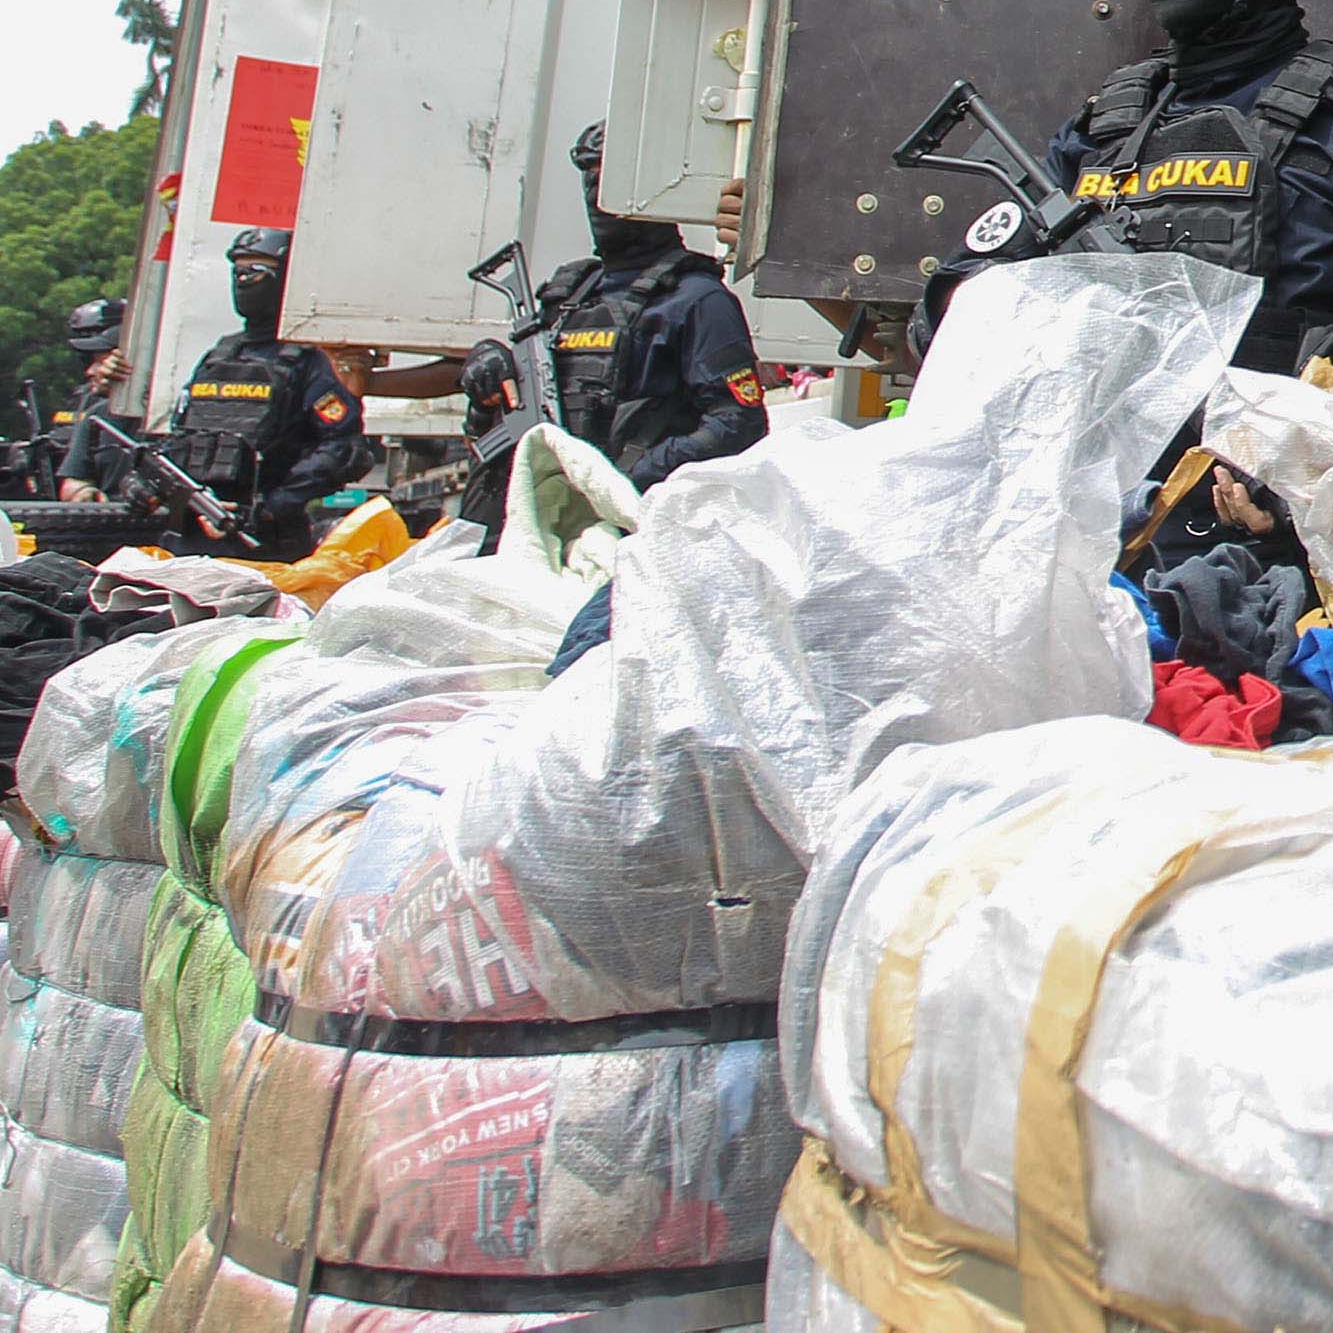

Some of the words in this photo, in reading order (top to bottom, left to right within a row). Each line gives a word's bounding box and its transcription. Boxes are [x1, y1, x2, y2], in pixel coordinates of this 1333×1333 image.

[1145, 158, 1250, 193] CUKAI
[191, 382, 218, 398] BEA
[220, 382, 271, 399] CUKAI
[475, 1106, 530, 1143] NEW
